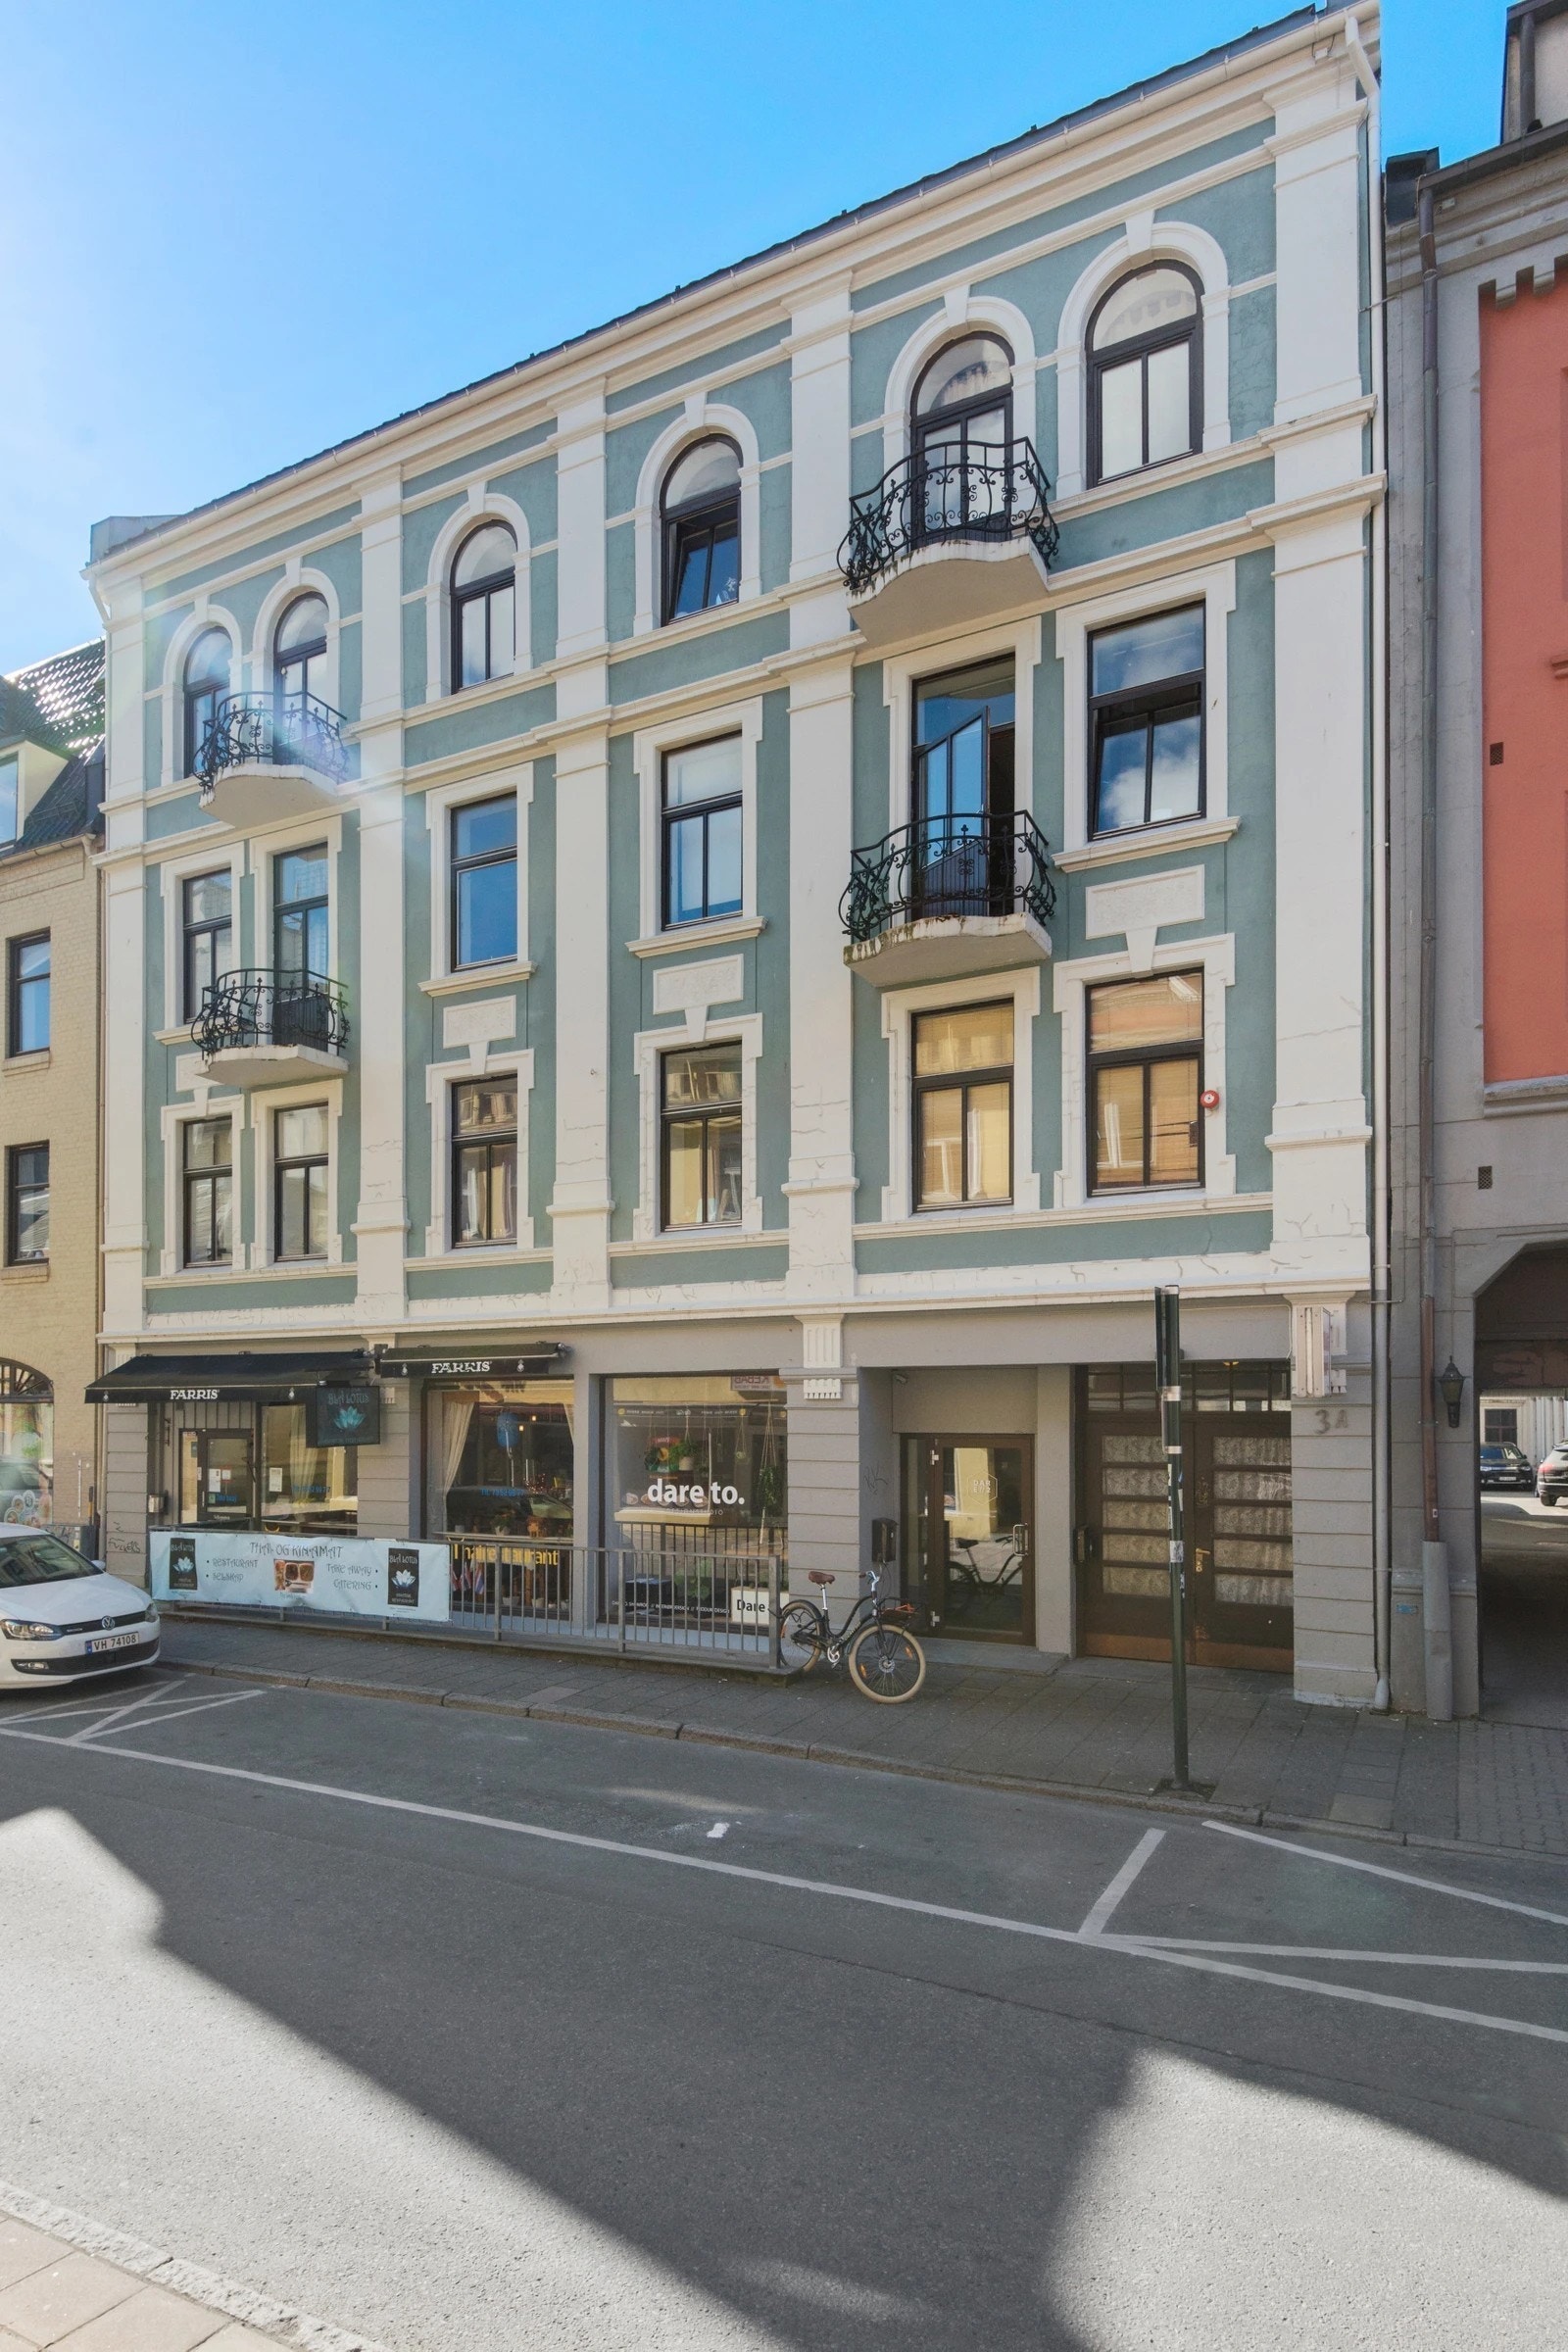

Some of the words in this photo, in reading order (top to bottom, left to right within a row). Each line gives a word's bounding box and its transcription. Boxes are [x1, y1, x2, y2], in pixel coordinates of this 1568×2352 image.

[430, 1360, 490, 1374] FARRIS
[170, 1389, 219, 1400] FARRIS
[647, 1478, 706, 1503] dare
[710, 1481, 746, 1505] to.
[275, 1544, 290, 1556] OG
[94, 1640, 107, 1650] VH
[111, 1635, 136, 1647] 74108
